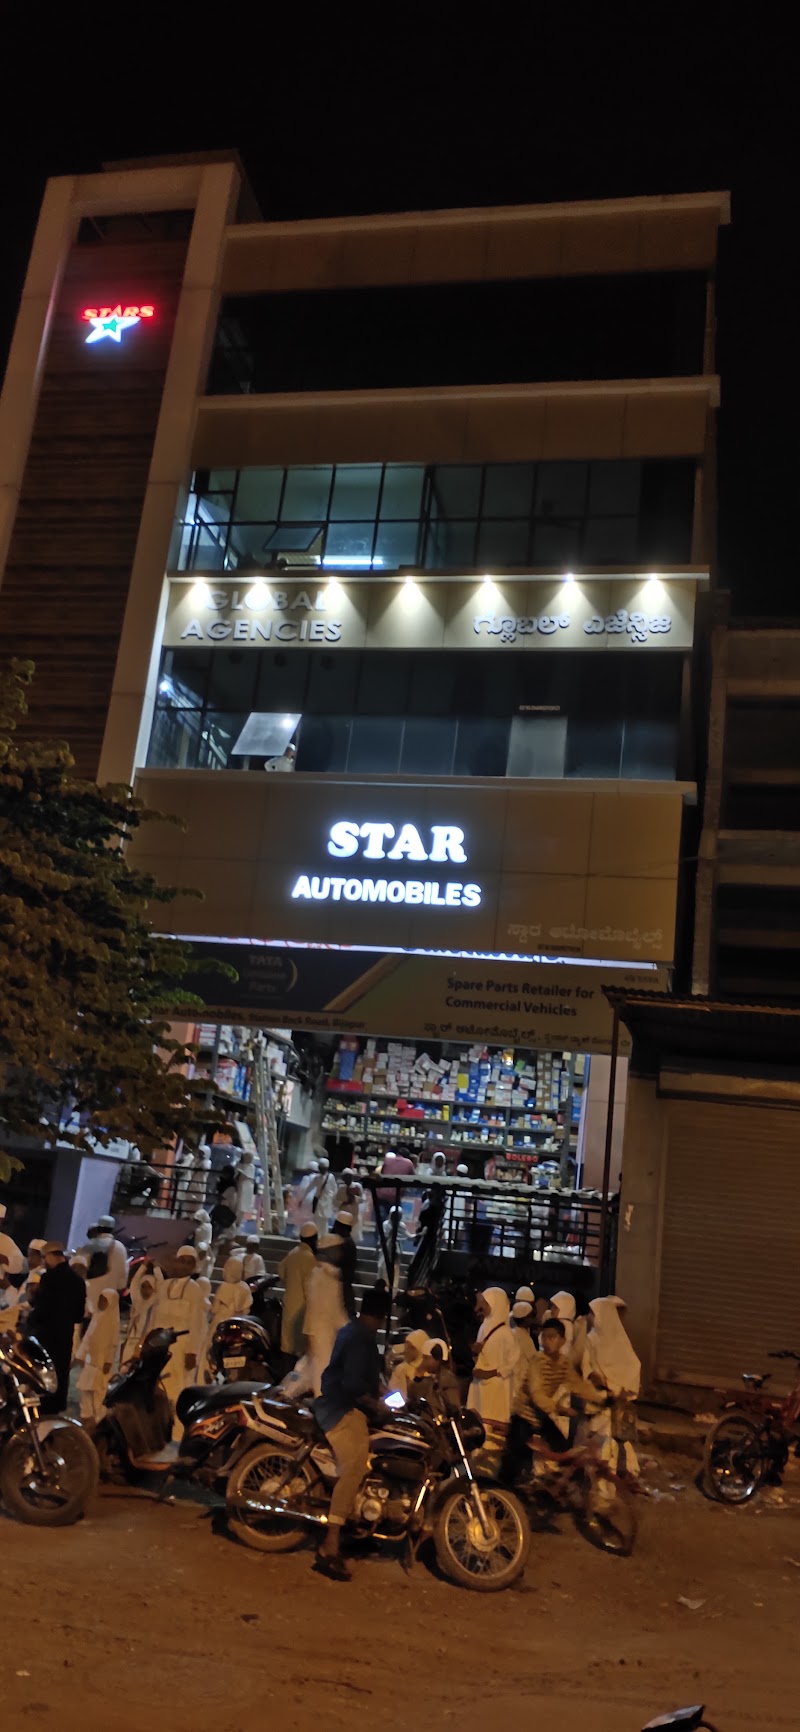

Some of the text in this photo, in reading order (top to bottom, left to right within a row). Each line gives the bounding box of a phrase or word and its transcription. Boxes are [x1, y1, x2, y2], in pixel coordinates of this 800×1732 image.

[82, 304, 155, 320] STARS
[181, 618, 343, 642] AGENCIES
[327, 820, 468, 864] STAR
[292, 874, 482, 908] AUTOMOBILES
[248, 954, 283, 967] TATA
[447, 977, 595, 999] Spare Parts Retailer for
[445, 996, 577, 1017] Commercial Vehicles
[505, 1152, 539, 1163] BOLERO
